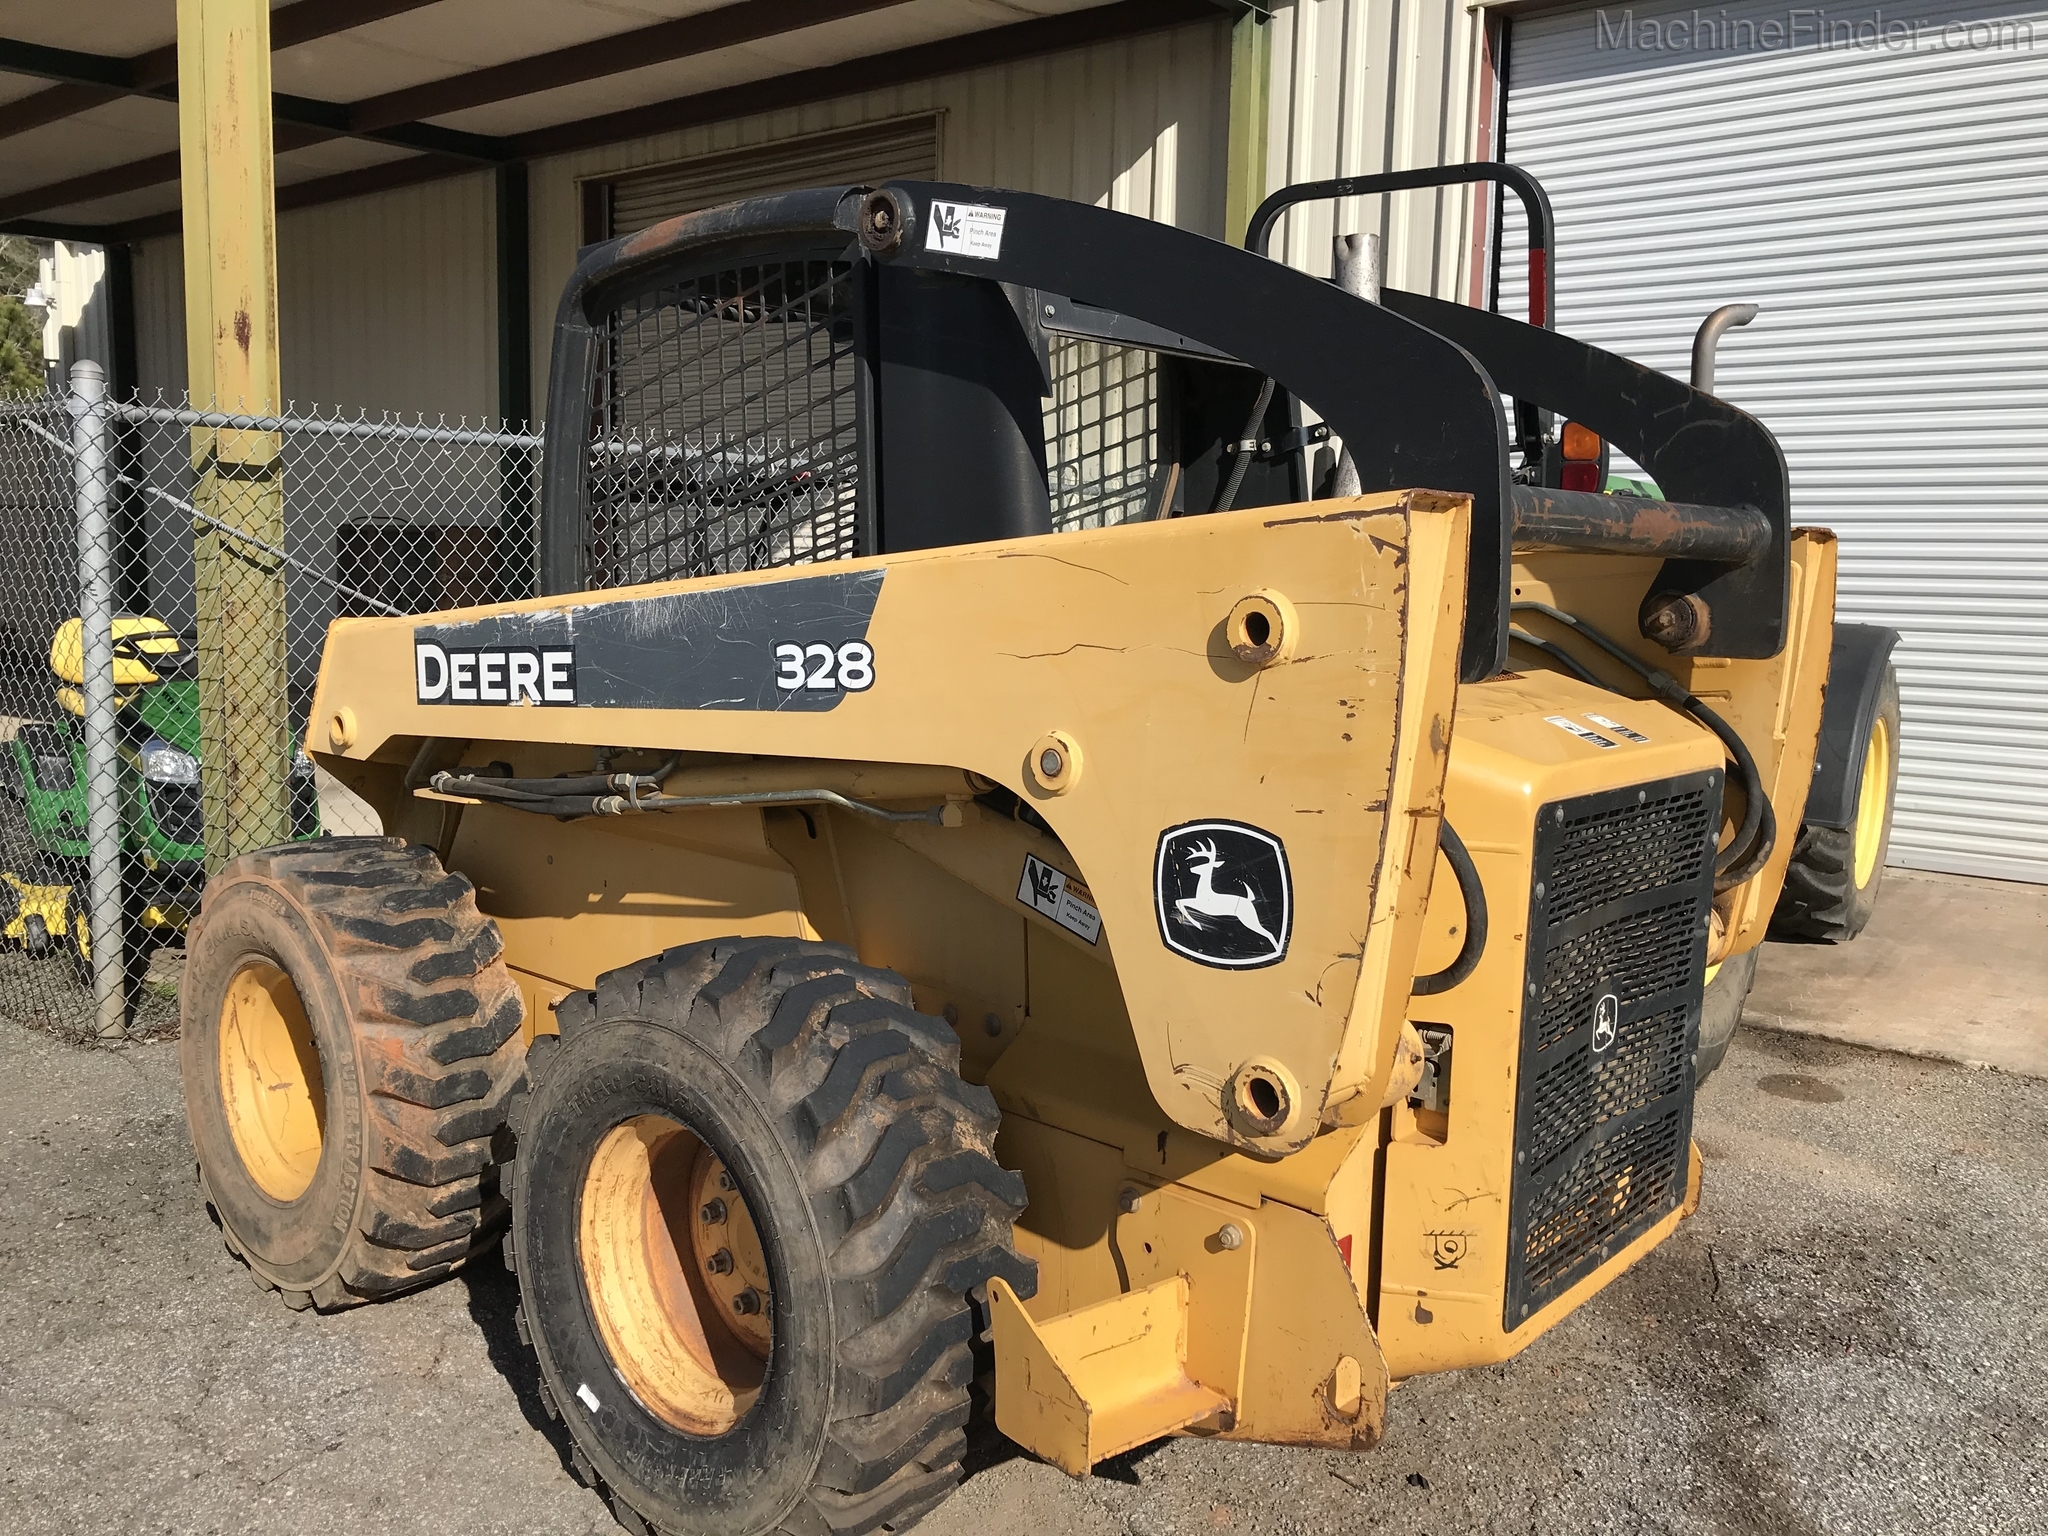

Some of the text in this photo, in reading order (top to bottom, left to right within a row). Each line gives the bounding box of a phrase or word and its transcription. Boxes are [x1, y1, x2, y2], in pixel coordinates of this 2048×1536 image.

[974, 211, 1002, 220] WARNING
[969, 227, 997, 238] Pinch Area
[416, 643, 575, 701] DEERE
[775, 641, 874, 690] 328
[1065, 900, 1096, 921] Pinch Area
[1066, 912, 1091, 931] Keep Away
[333, 1051, 362, 1235] SUPER TRACTION
